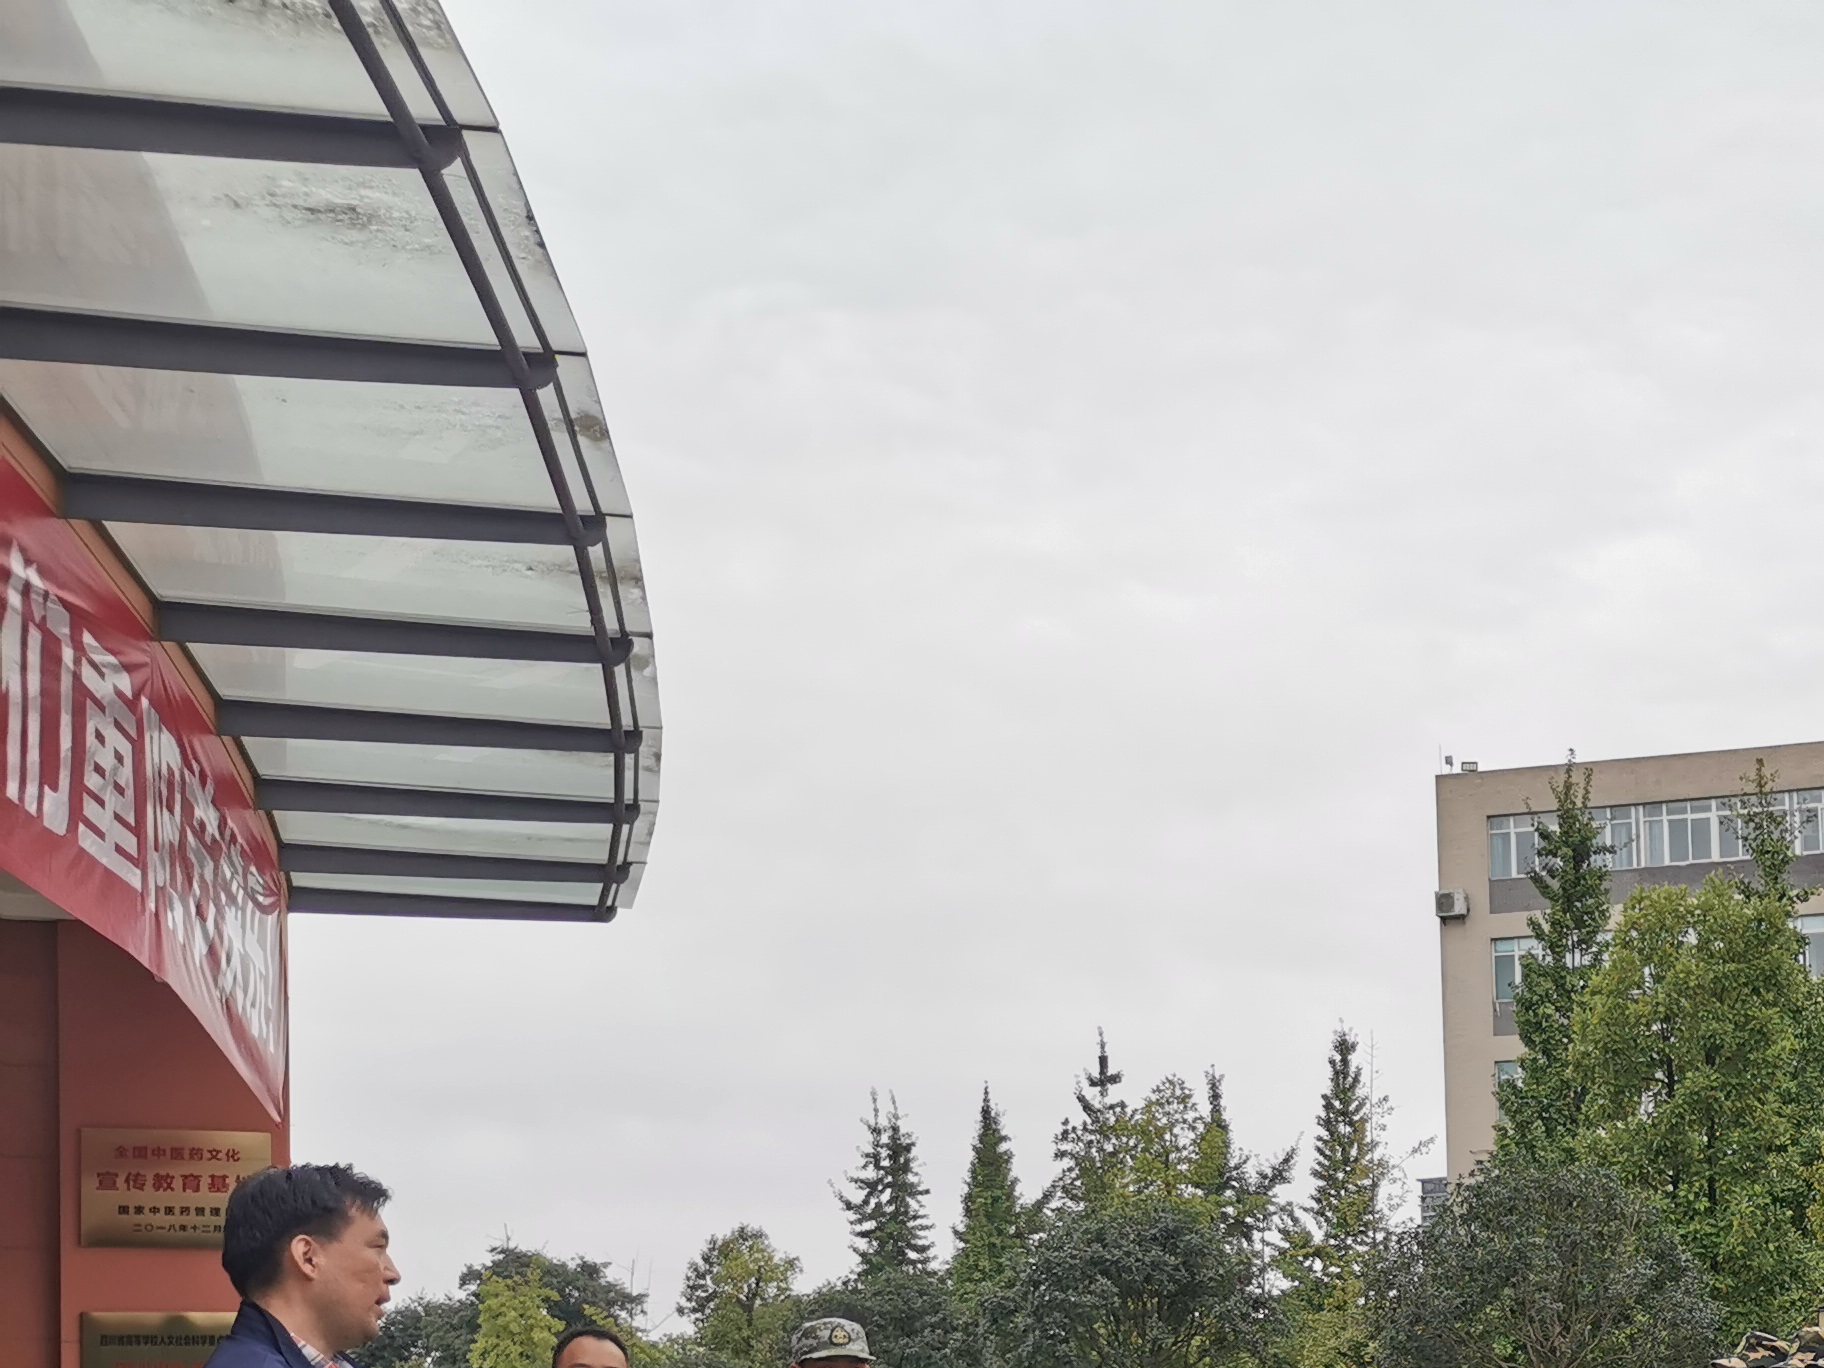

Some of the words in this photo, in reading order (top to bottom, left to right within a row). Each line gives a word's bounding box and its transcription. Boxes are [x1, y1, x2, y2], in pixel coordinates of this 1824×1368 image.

[113, 1145, 241, 1162] 全国中医药文化
[96, 1170, 250, 1194] 宣传教育基
[117, 1204, 229, 1217] 国家中医药管理
[132, 1223, 226, 1233] 二〇一八年十二月
